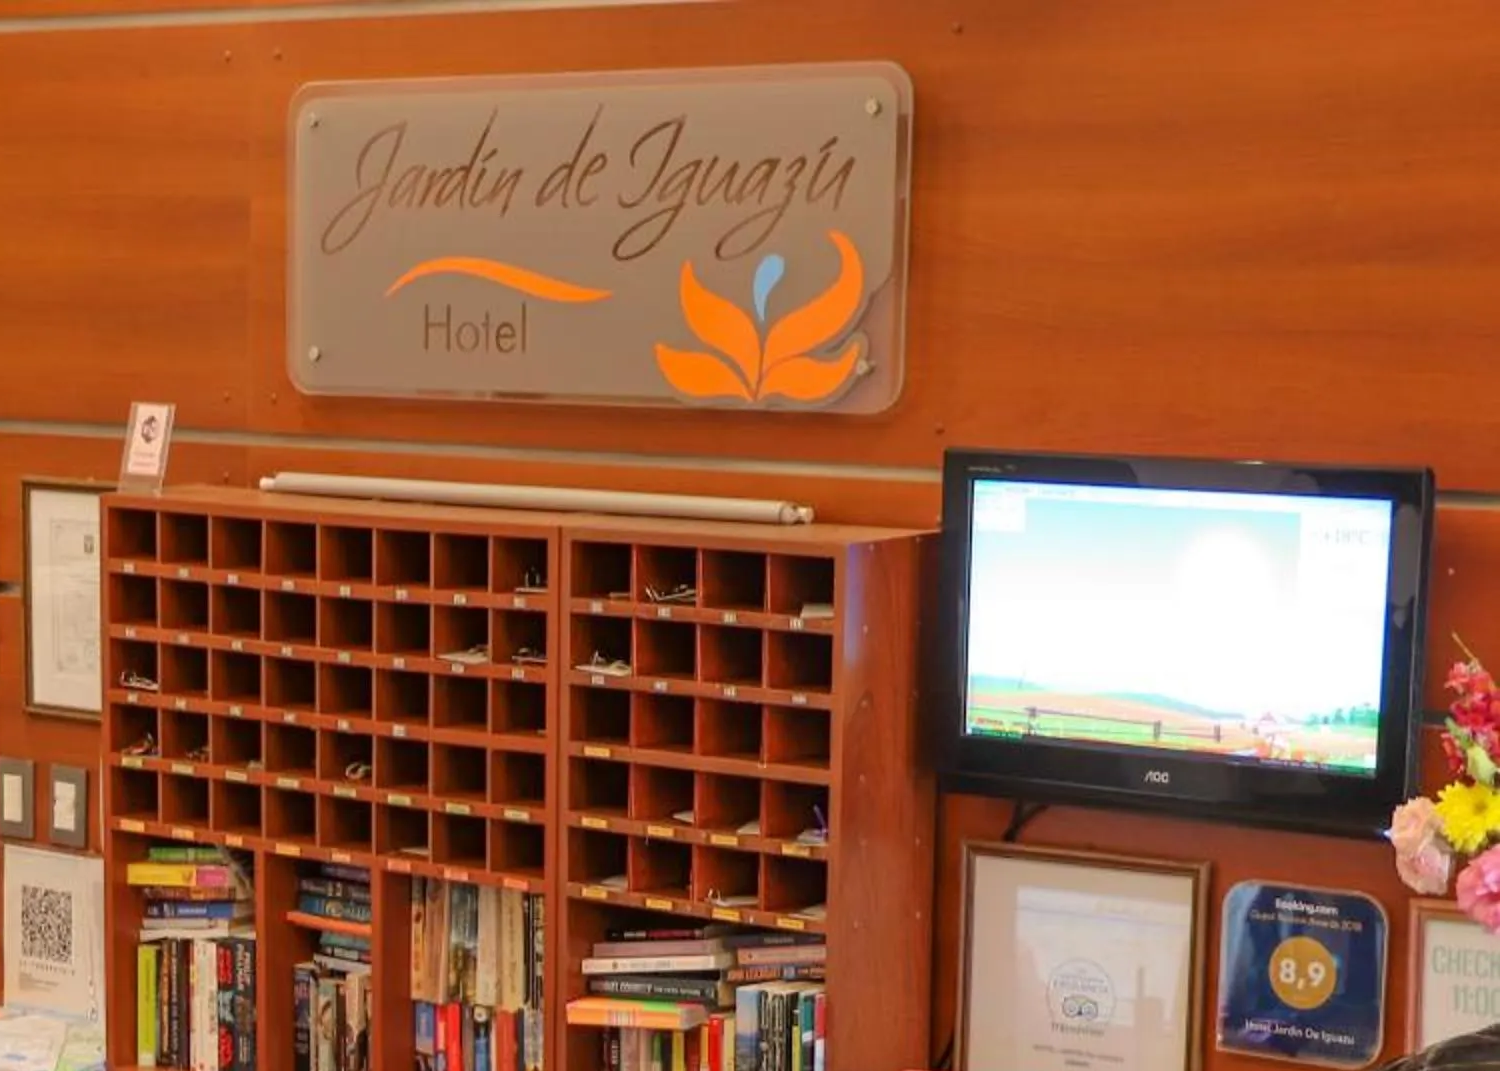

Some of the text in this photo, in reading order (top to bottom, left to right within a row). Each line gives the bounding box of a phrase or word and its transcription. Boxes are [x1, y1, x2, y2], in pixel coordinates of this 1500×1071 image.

[321, 104, 857, 261] Jardín de Iguazú
[423, 303, 528, 354] Hotel
[1144, 771, 1169, 783] AOC
[1275, 898, 1339, 915] Booking.com
[1279, 957, 1326, 990] 8,9
